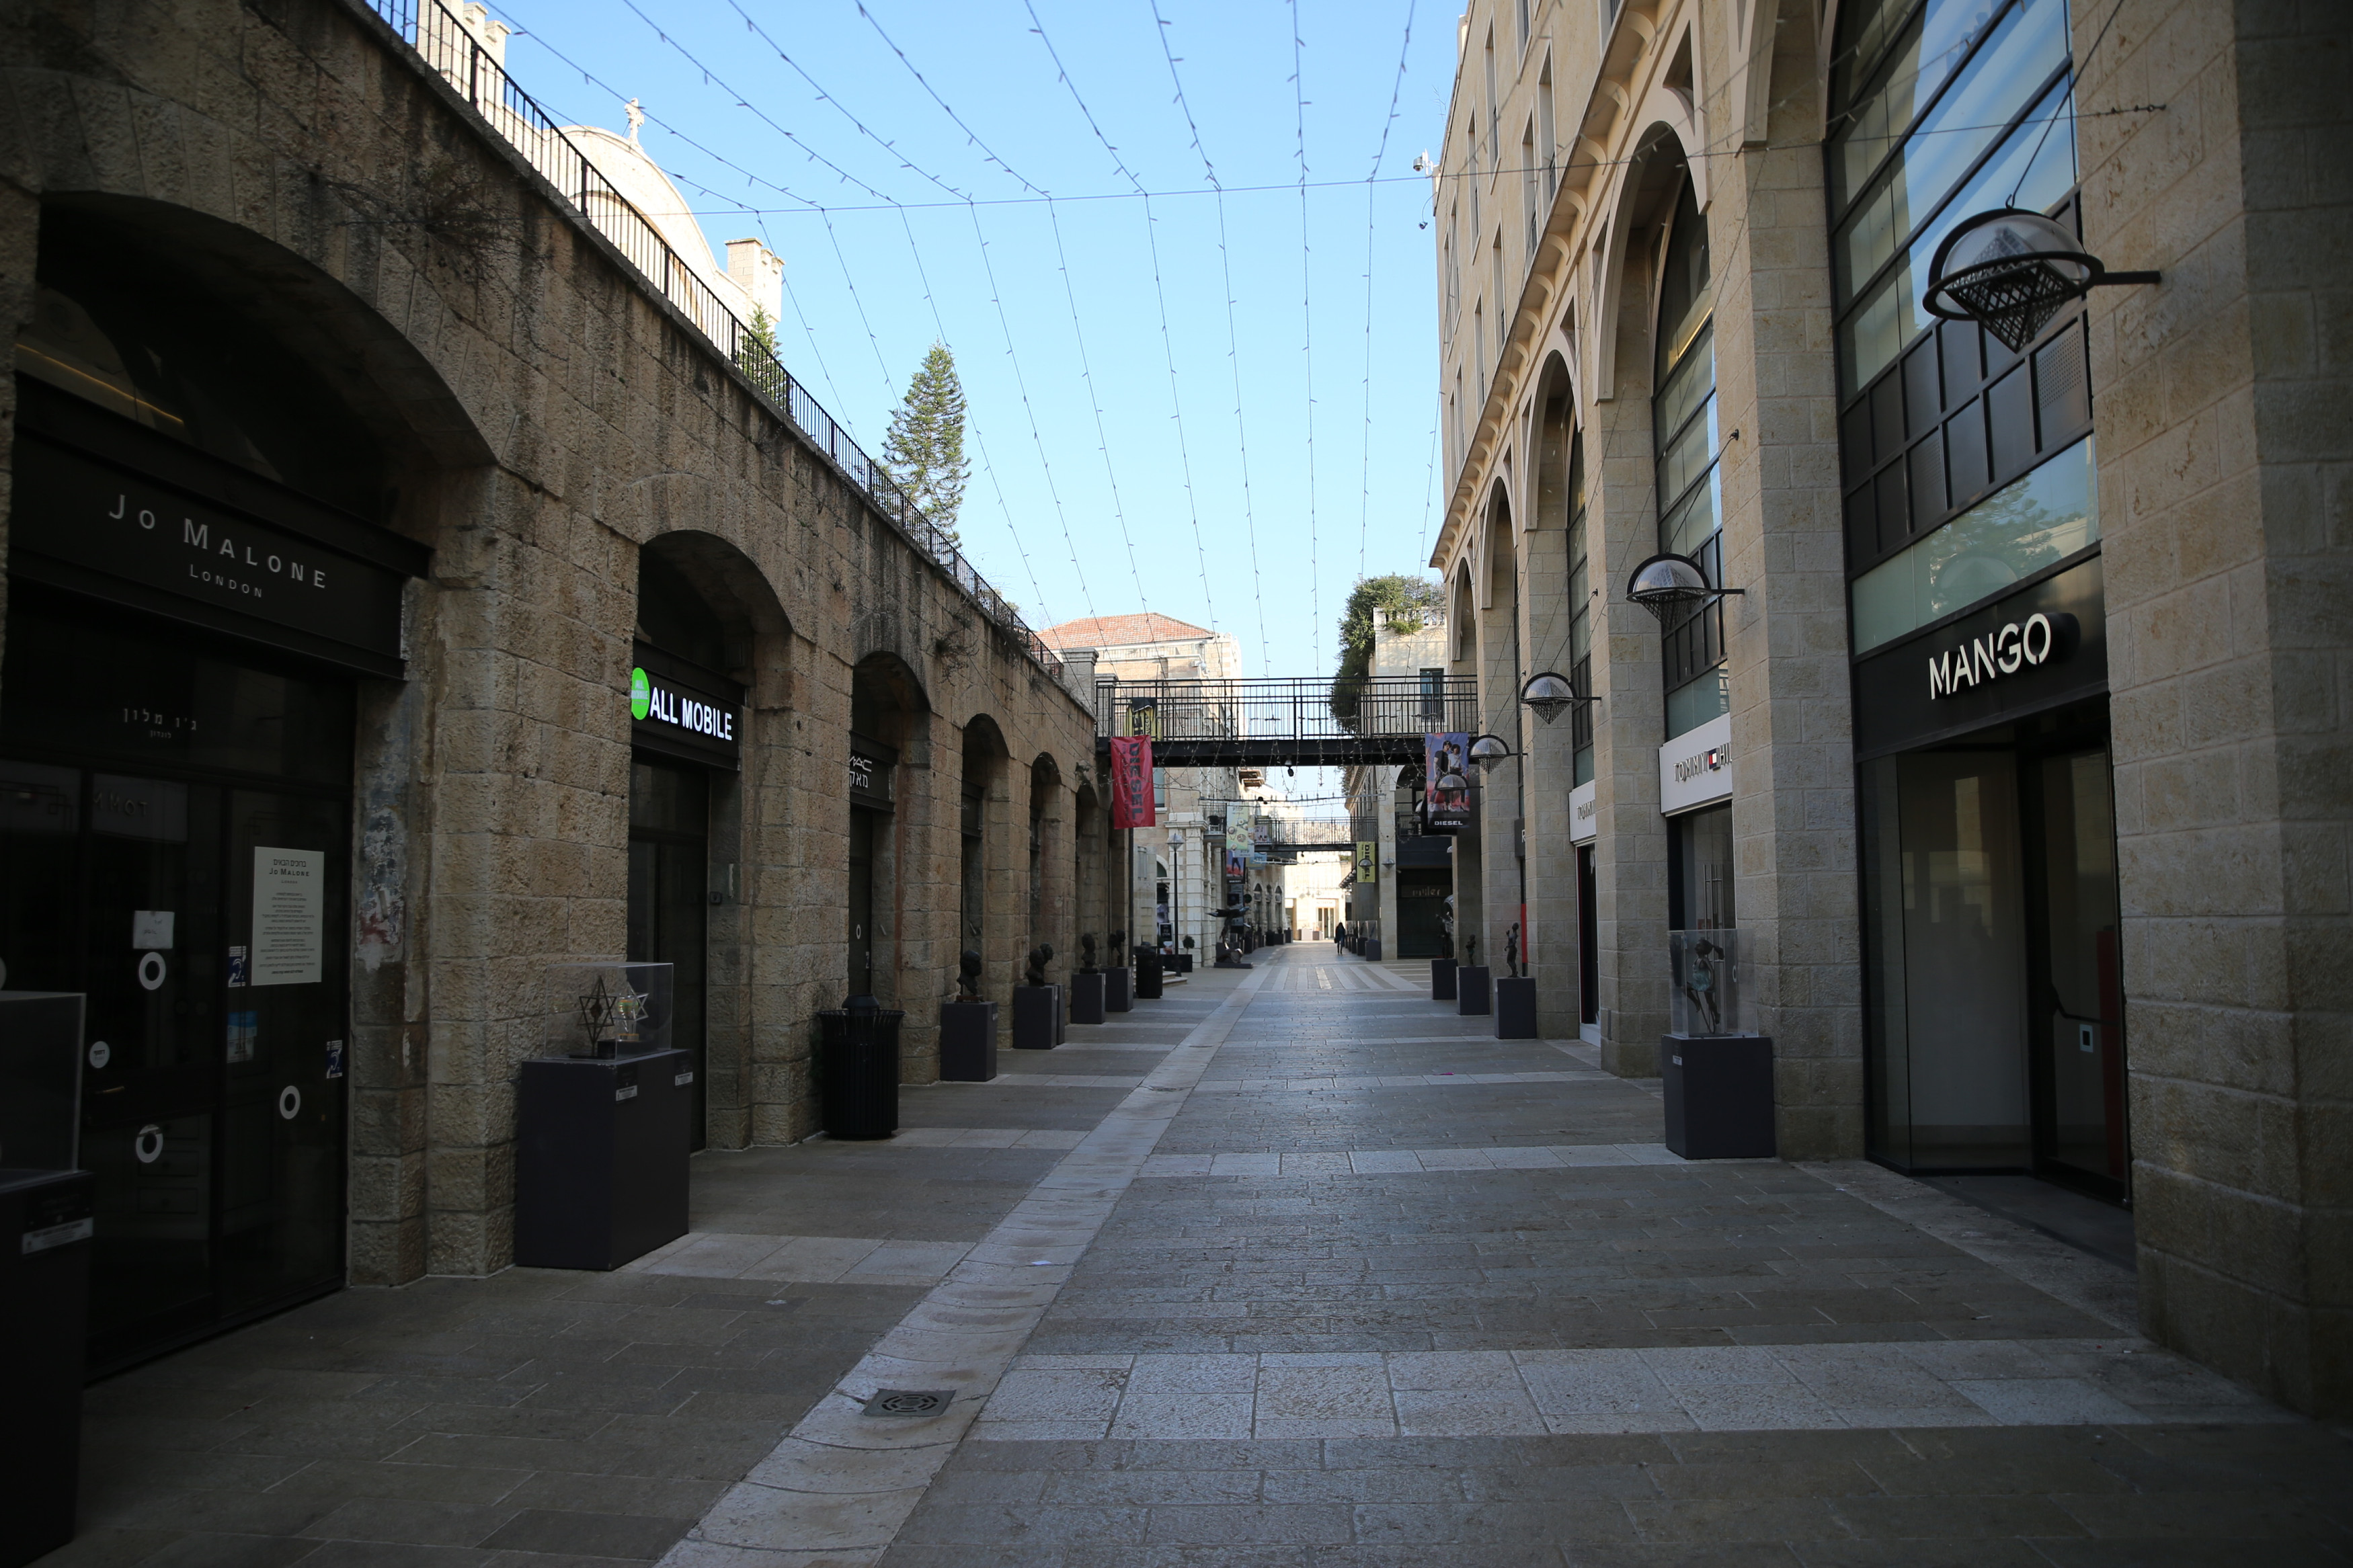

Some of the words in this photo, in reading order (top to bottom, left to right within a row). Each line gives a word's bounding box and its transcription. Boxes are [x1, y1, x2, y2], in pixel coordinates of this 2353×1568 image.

[183, 517, 327, 589] MALONE
[188, 563, 263, 599] LONDON
[1928, 612, 2052, 700] MANGO
[123, 708, 163, 725] מלון
[649, 686, 678, 725] ALL
[682, 698, 733, 741] MOBILE
[849, 771, 869, 788] מאק
[1129, 743, 1143, 820] DIESEL
[1673, 751, 1708, 782] TOMMY
[280, 868, 310, 877] MALONE
